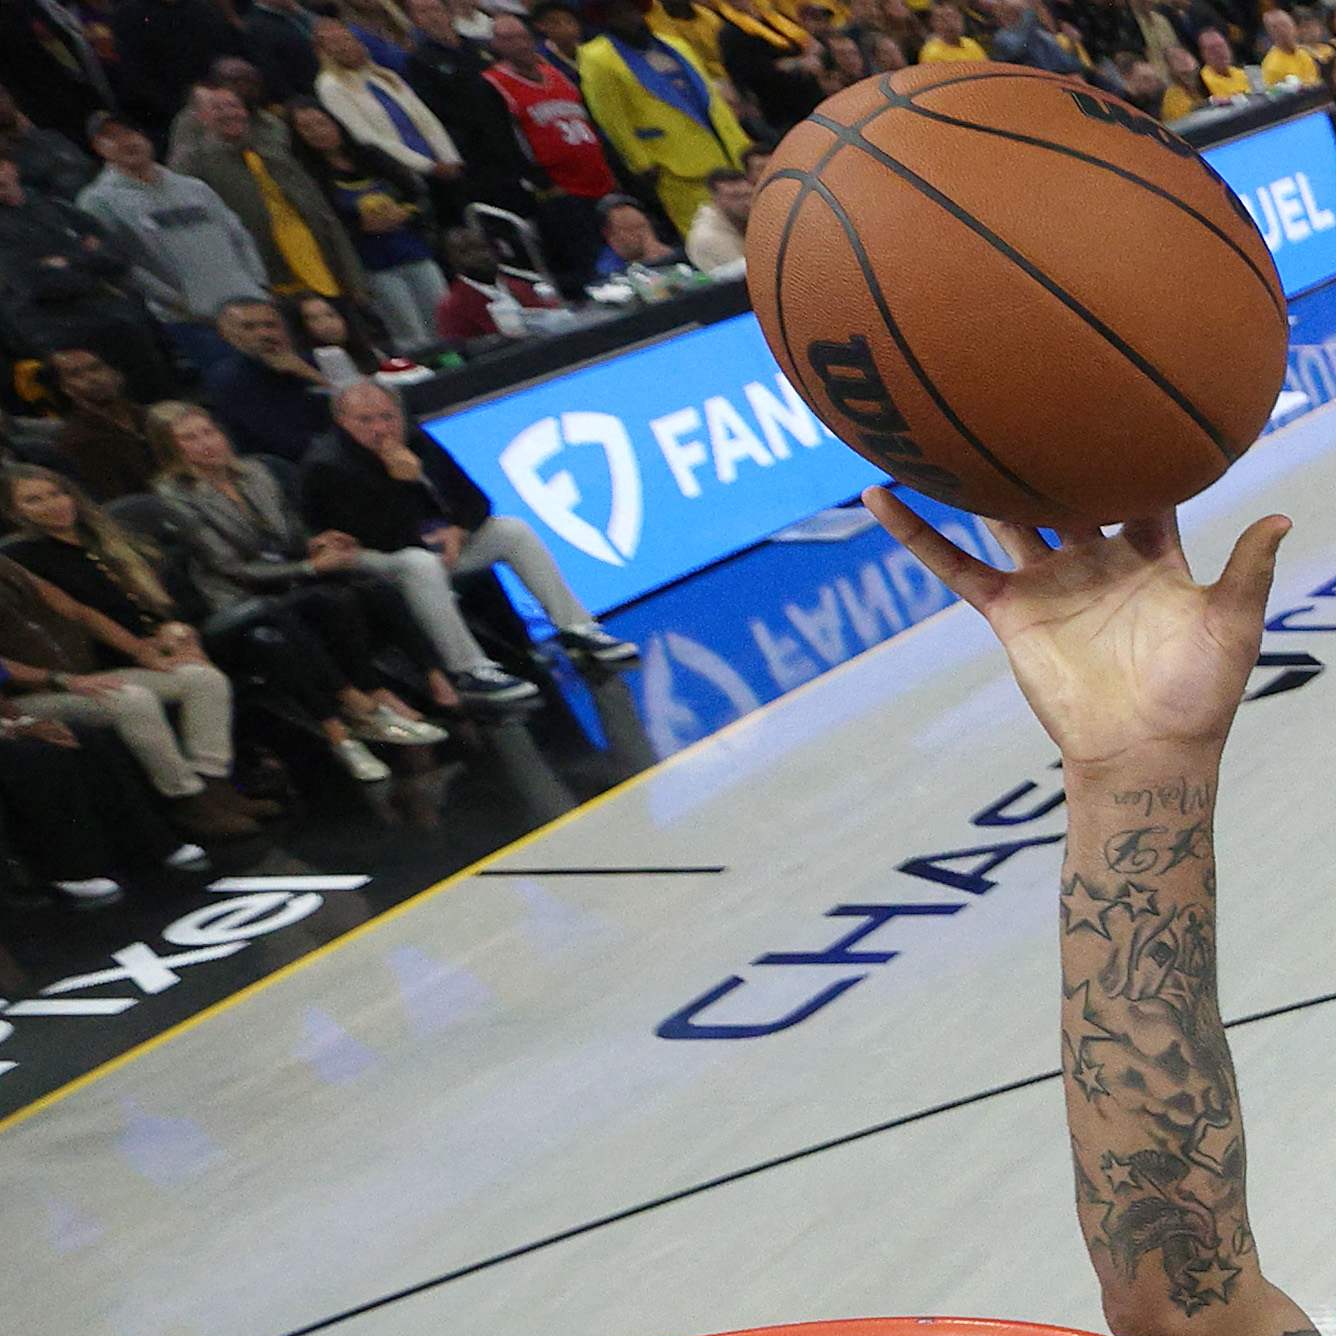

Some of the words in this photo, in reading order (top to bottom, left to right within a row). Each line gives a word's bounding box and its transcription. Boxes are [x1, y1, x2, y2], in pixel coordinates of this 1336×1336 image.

[1240, 170, 1336, 252] UEL
[648, 372, 834, 498] FAN
[0, 874, 374, 1075] ixel
